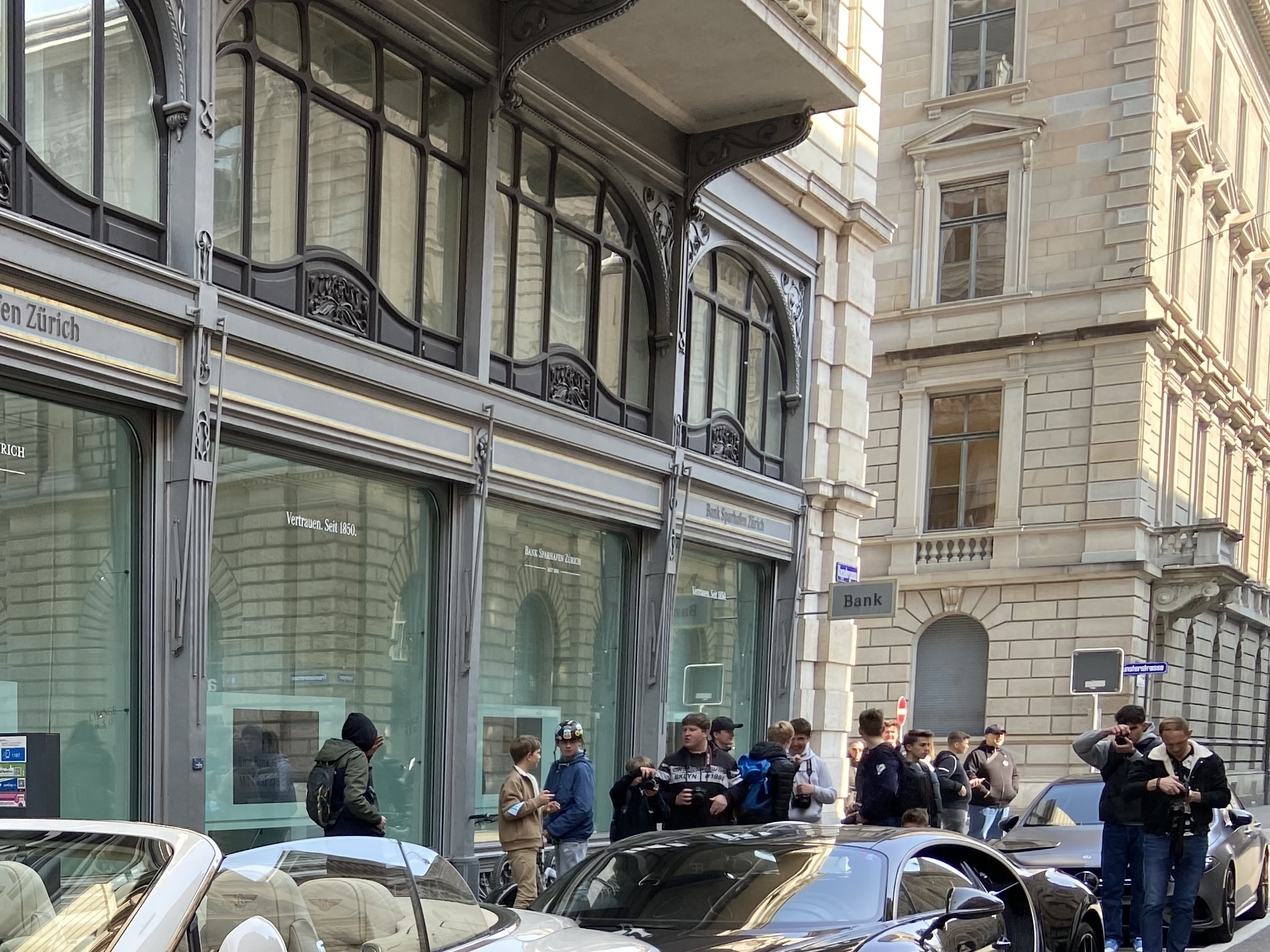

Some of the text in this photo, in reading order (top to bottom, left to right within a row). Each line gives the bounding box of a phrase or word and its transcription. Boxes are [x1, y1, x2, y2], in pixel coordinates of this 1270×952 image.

[26, 303, 80, 343] Zürich
[286, 511, 357, 537] Vertrauen. Seit 1850.
[843, 593, 883, 608] Bank
